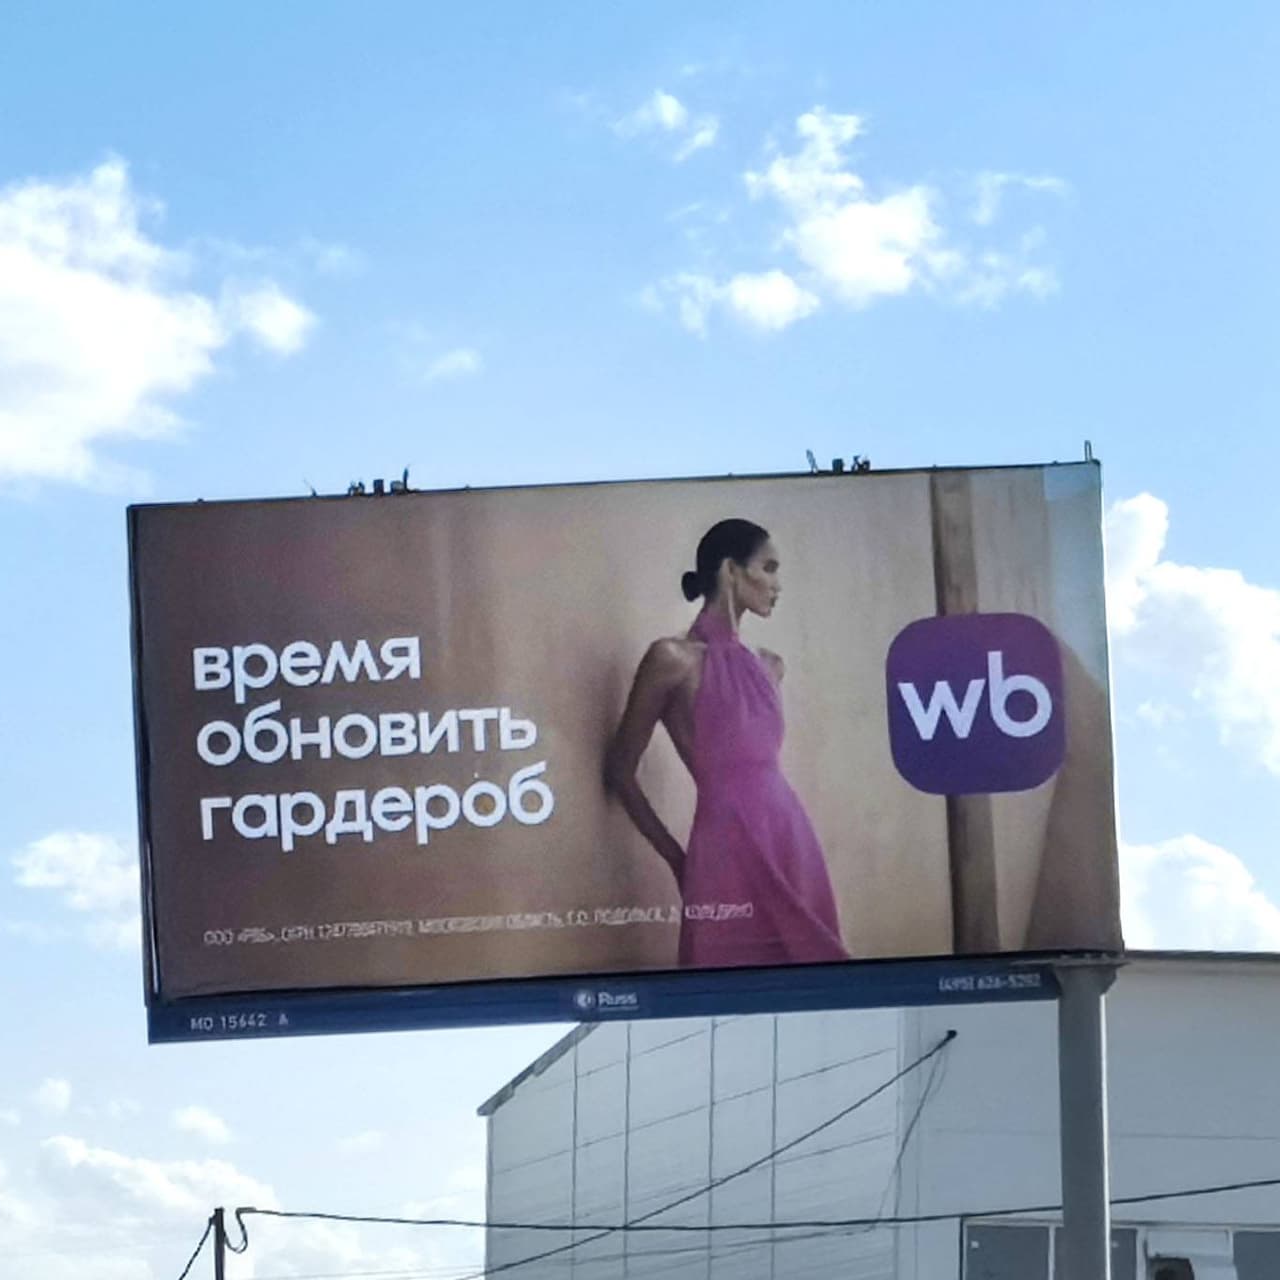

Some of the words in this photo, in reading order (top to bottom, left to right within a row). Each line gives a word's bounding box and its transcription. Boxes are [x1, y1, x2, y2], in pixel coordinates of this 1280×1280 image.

[193, 636, 421, 704] время
[897, 650, 1052, 741] wb
[197, 699, 537, 766] обновить
[200, 761, 554, 852] гардероб
